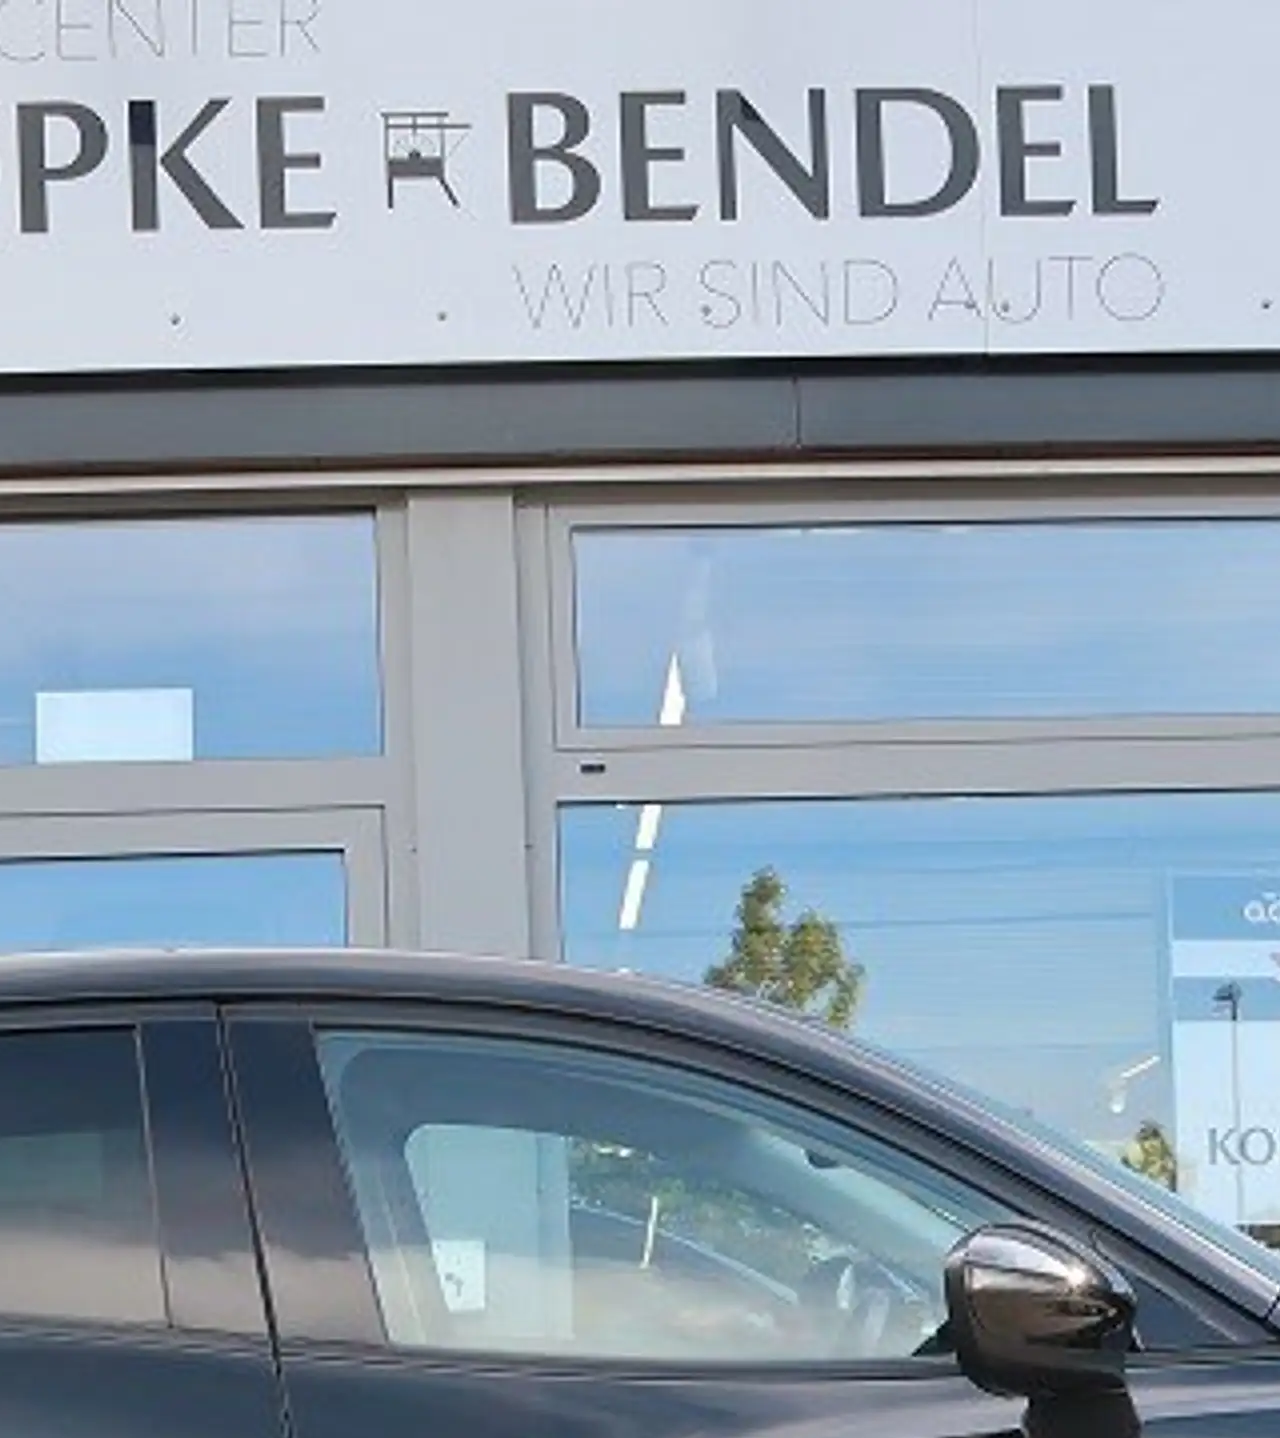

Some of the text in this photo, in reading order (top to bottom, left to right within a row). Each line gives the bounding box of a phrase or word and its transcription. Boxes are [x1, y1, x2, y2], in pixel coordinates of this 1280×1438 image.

[506, 84, 1160, 225] BENDEL
[511, 252, 1166, 329] WIR SIND AUTO
